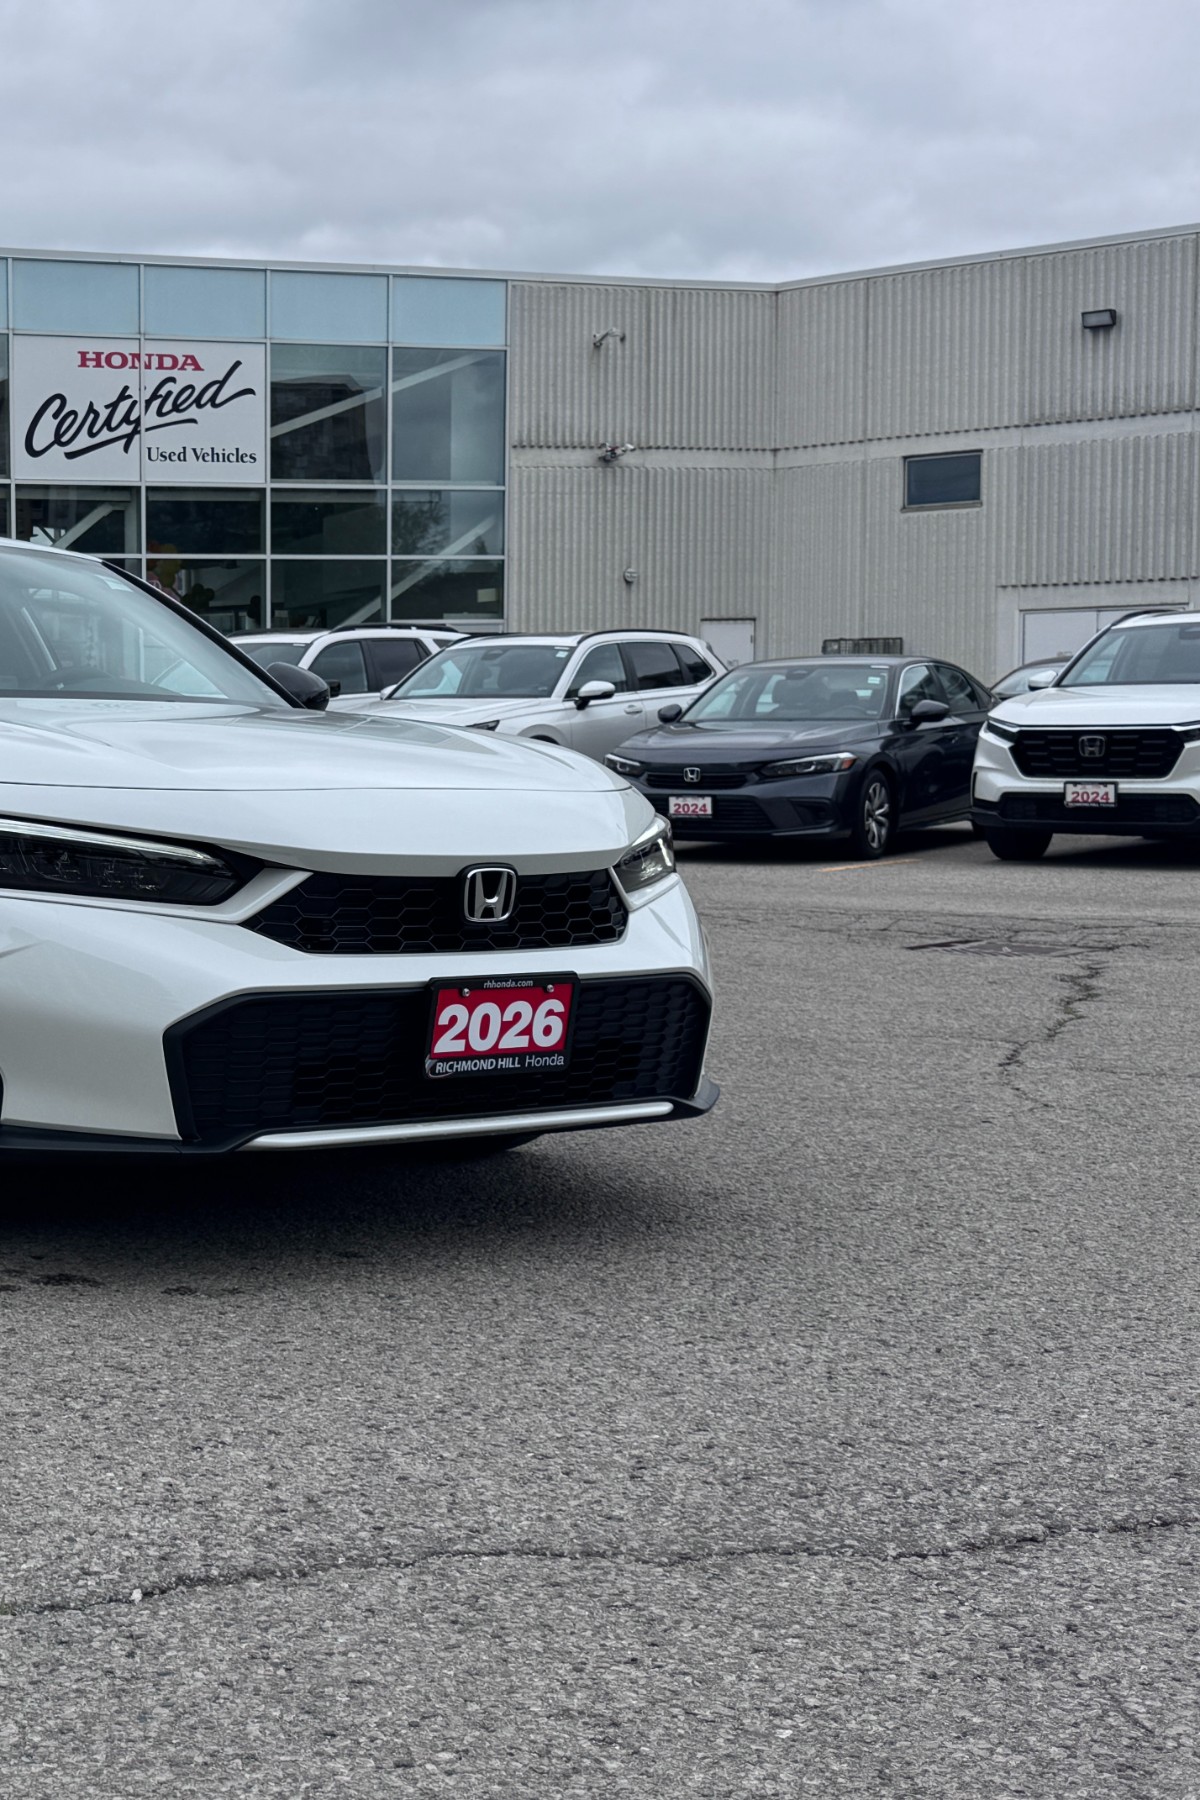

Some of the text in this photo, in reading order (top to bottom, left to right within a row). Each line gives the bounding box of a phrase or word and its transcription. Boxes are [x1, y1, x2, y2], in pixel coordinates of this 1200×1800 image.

[77, 351, 204, 371] HONDA
[24, 360, 256, 458] Certified
[147, 446, 257, 464] Used Vehicles
[1071, 791, 1110, 803] 2024
[674, 803, 707, 814] 2024
[484, 979, 534, 989] rhhonda.com
[433, 999, 565, 1053] 2026
[435, 1053, 565, 1074] RICHMOND HILL Honda
